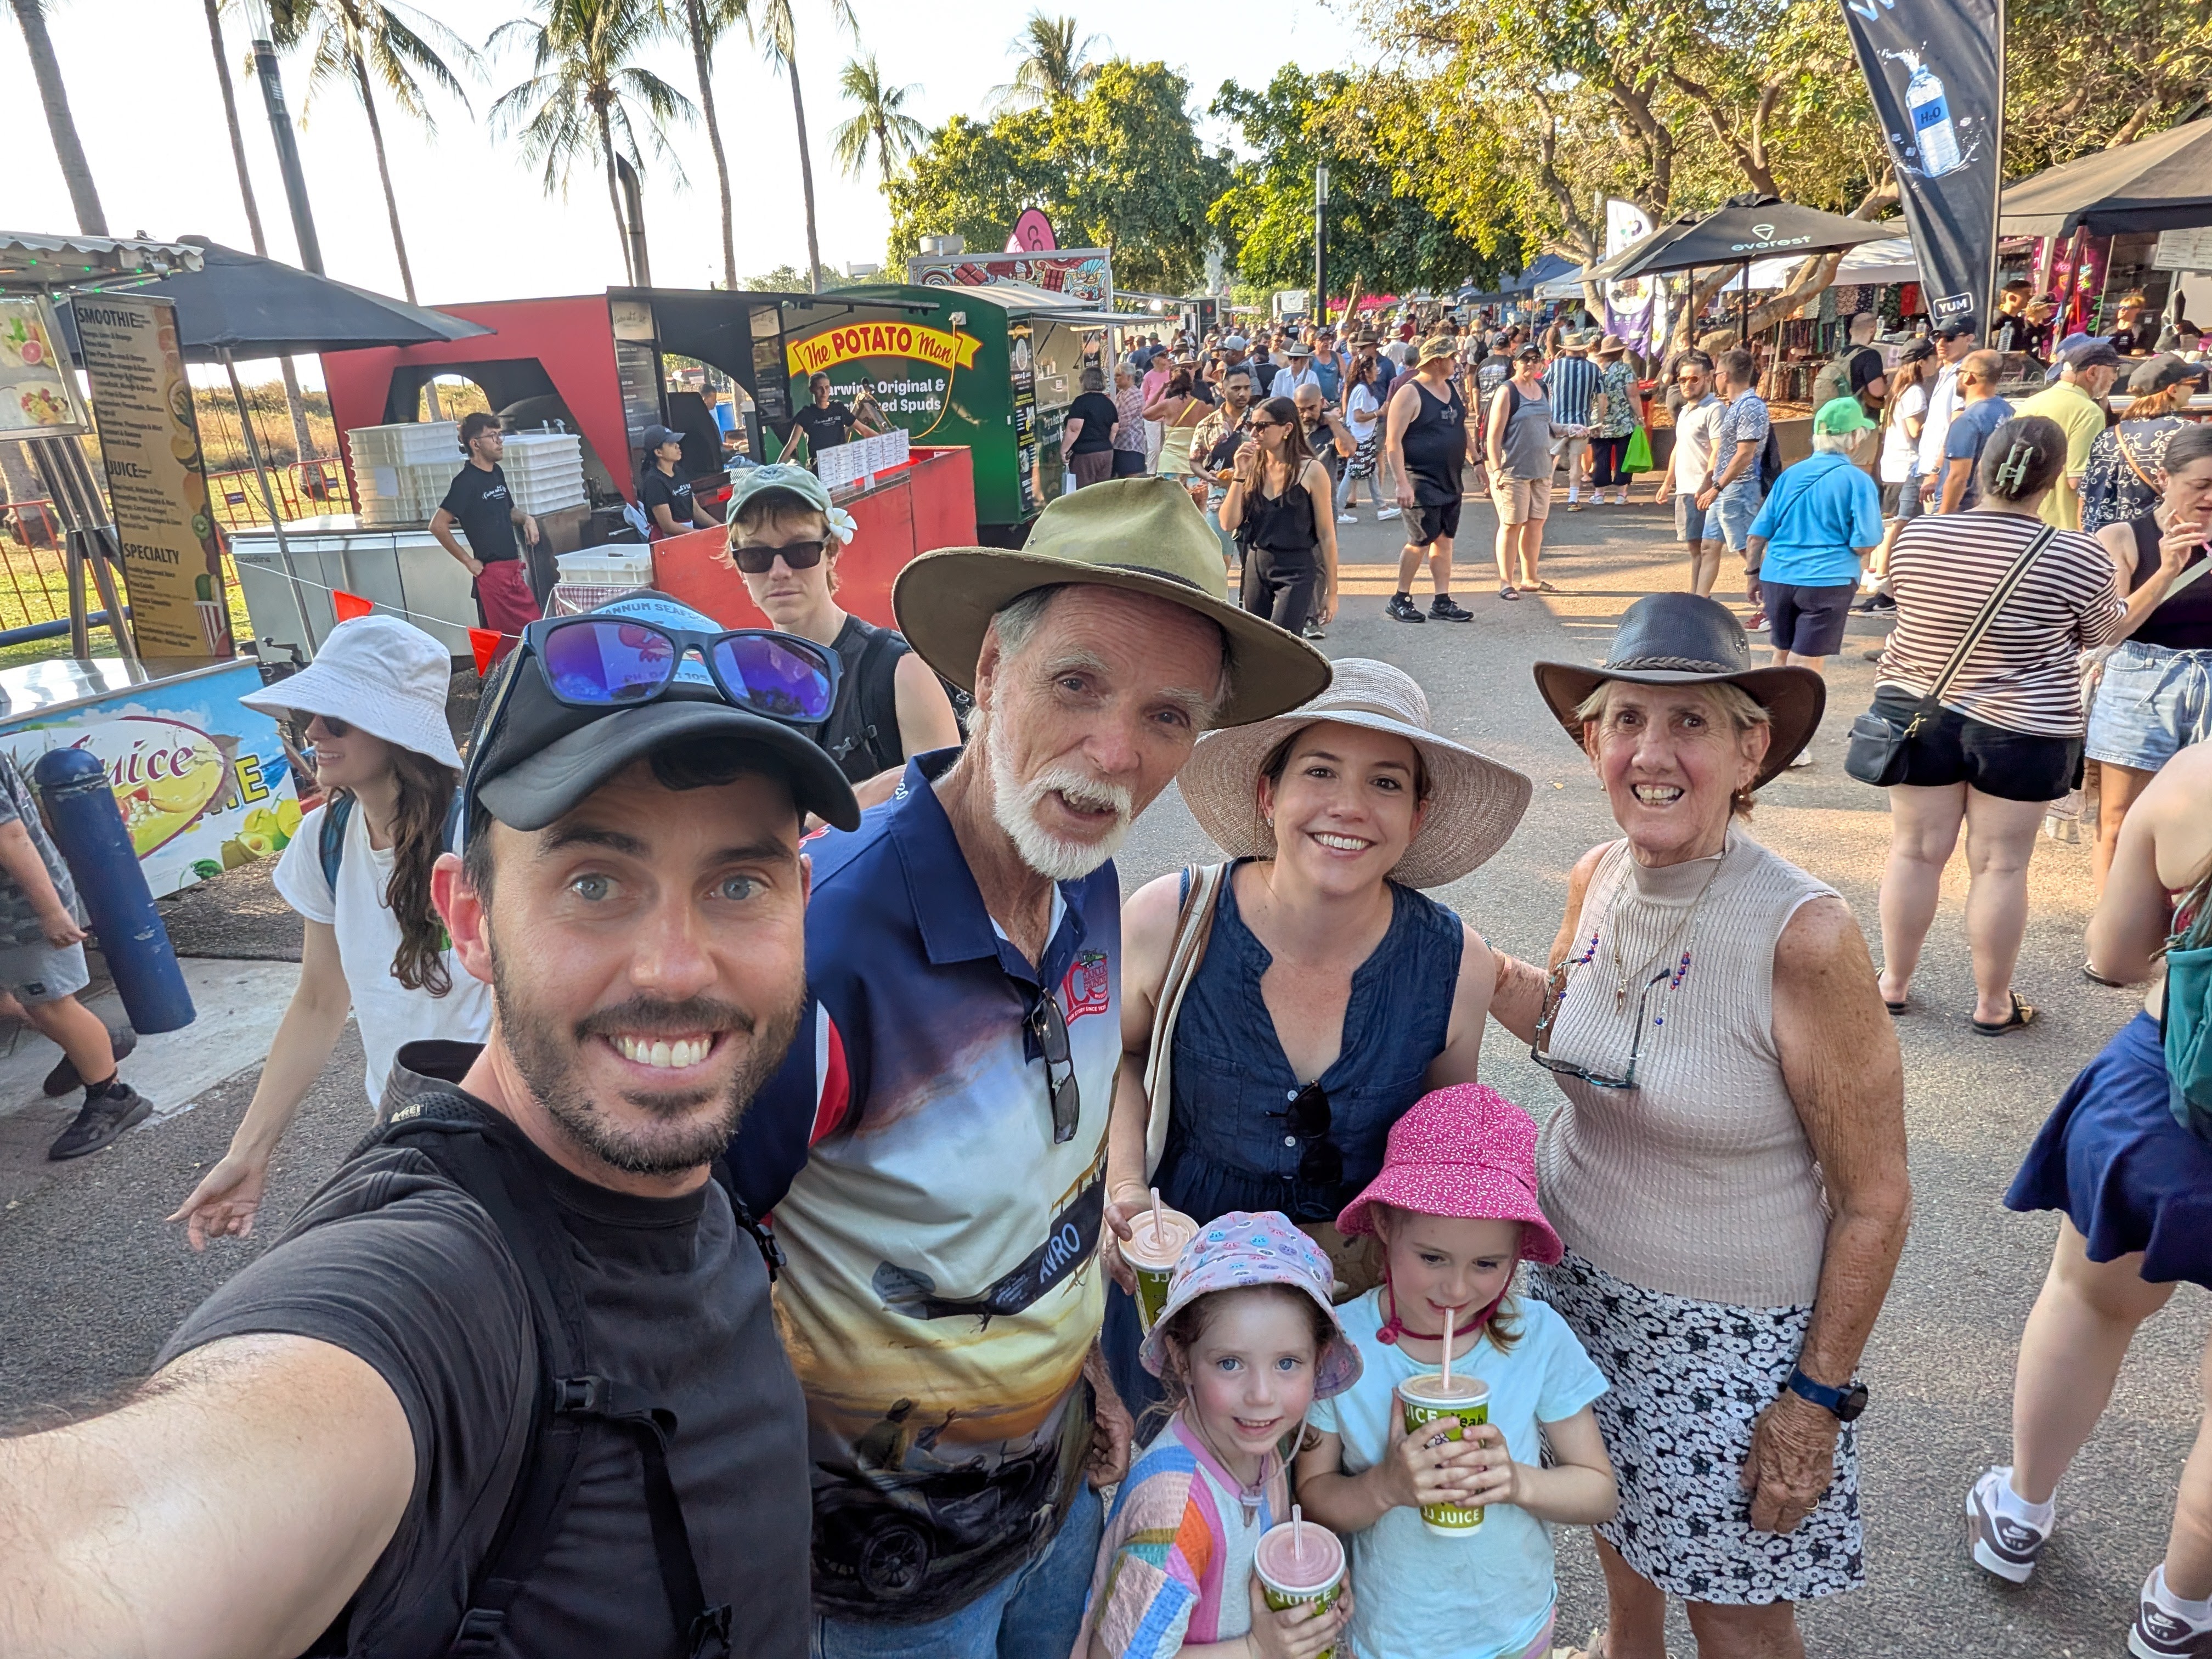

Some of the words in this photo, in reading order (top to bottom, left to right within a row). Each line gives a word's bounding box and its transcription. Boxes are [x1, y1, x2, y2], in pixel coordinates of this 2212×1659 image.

[1731, 235, 1810, 251] everest
[1938, 298, 1967, 313] YUM
[78, 307, 138, 328] SMOOTHIE
[803, 342, 831, 369] The
[831, 326, 912, 358] POTATO
[917, 332, 953, 363] Man
[877, 379, 932, 396] Original
[935, 379, 945, 392] &
[900, 398, 941, 414] Spuds
[109, 461, 138, 478] JUICE
[124, 543, 179, 565] SPECIALTY
[1075, 1007, 1085, 1017] STORY
[1040, 1223, 1080, 1284] AVRO
[1150, 1272, 1170, 1283] JJ
[1404, 1402, 1437, 1424] UICE
[1438, 1509, 1480, 1523] JUICE
